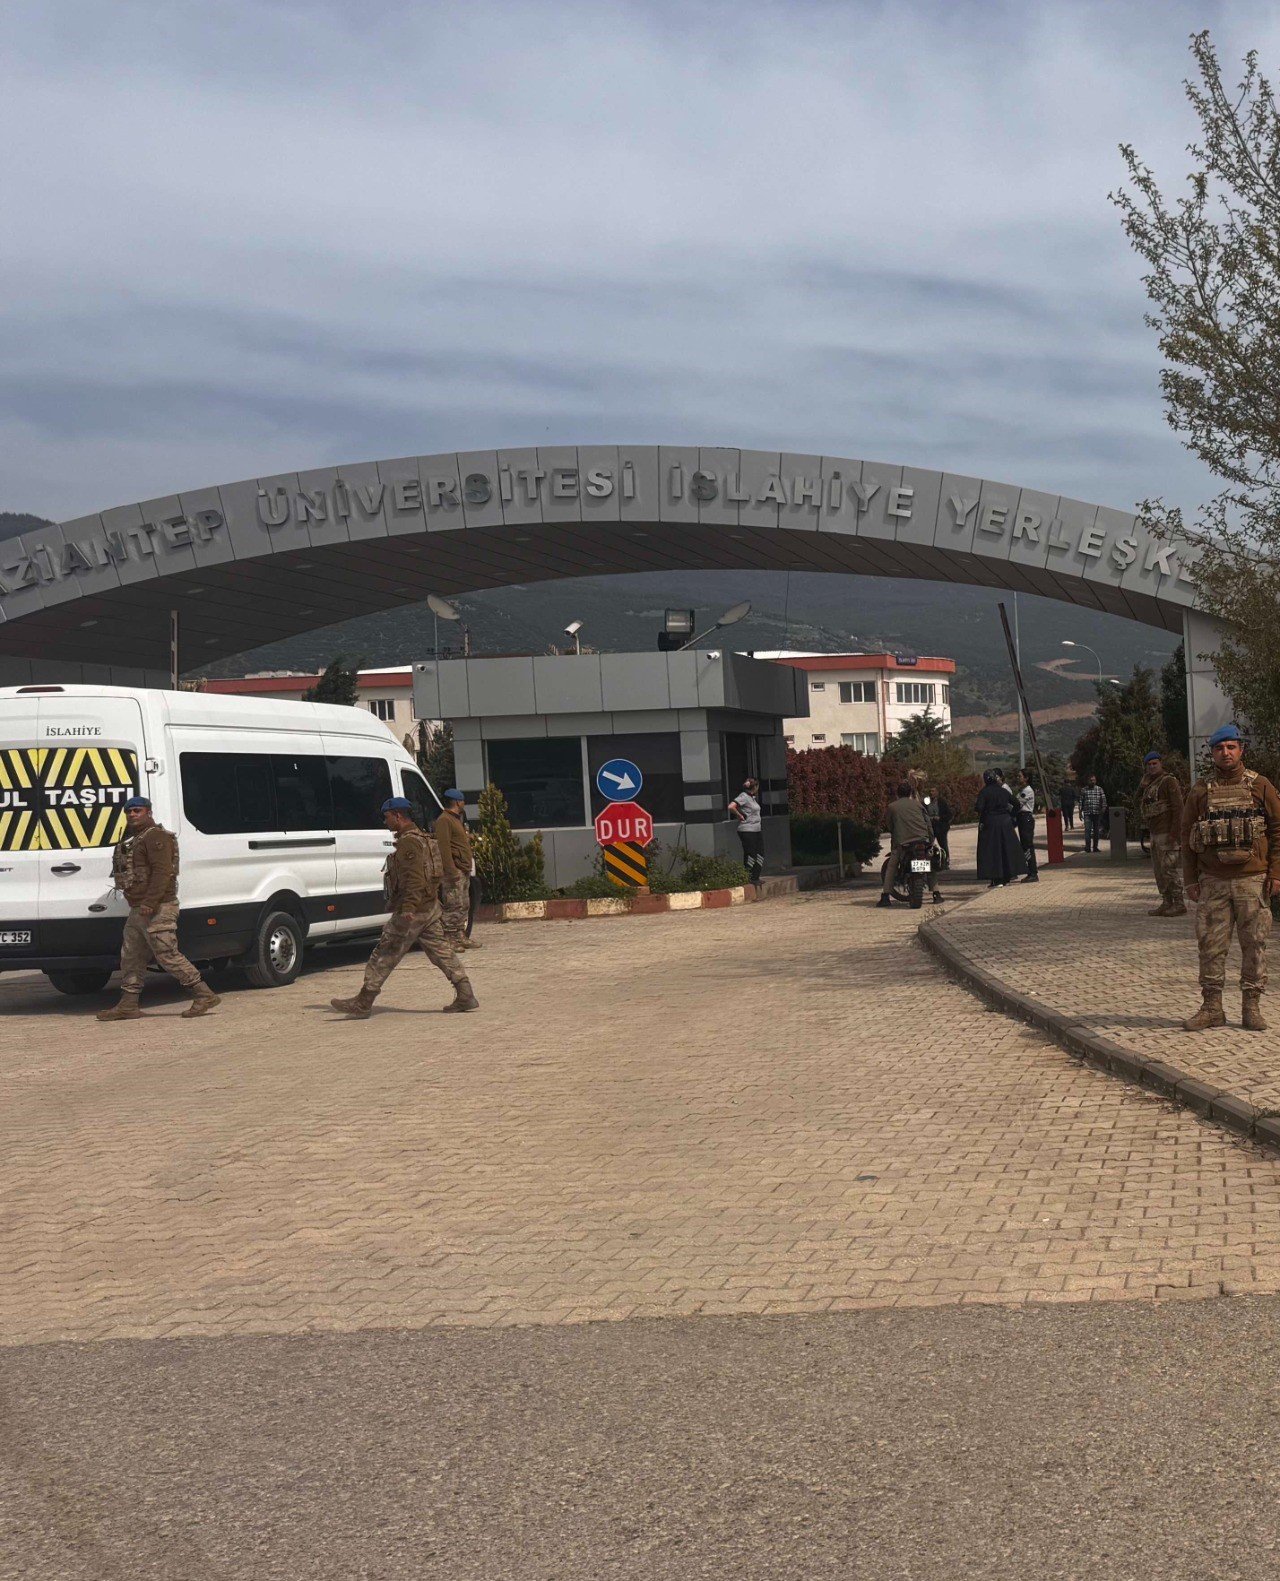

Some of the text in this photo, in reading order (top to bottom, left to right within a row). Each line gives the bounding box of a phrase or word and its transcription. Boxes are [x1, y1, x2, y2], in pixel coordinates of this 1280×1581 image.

[0, 509, 223, 593] ZİANTEP
[257, 461, 634, 524] ÜNİVERSİTESİ
[671, 462, 914, 518] İSLAHİYE
[46, 726, 101, 736] İSLAHİYE
[45, 787, 134, 807] TAŞITI
[600, 818, 648, 839] DUR
[0, 932, 29, 943] C 352
